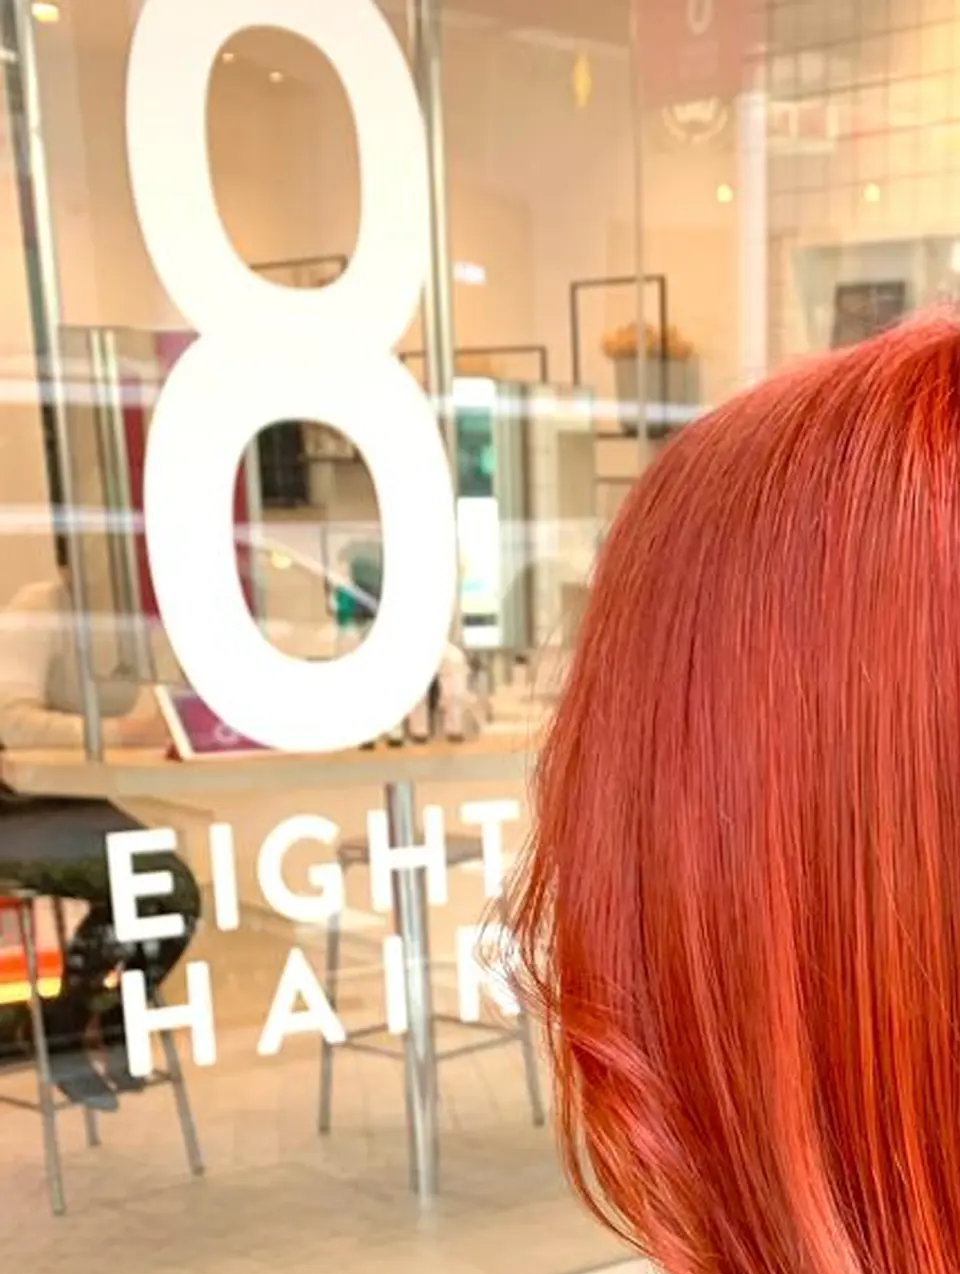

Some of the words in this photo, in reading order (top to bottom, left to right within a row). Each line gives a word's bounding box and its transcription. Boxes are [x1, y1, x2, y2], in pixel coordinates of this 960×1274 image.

[126, 0, 457, 752] 8
[105, 800, 520, 943] EIGHT
[121, 924, 524, 1078] HAIR
